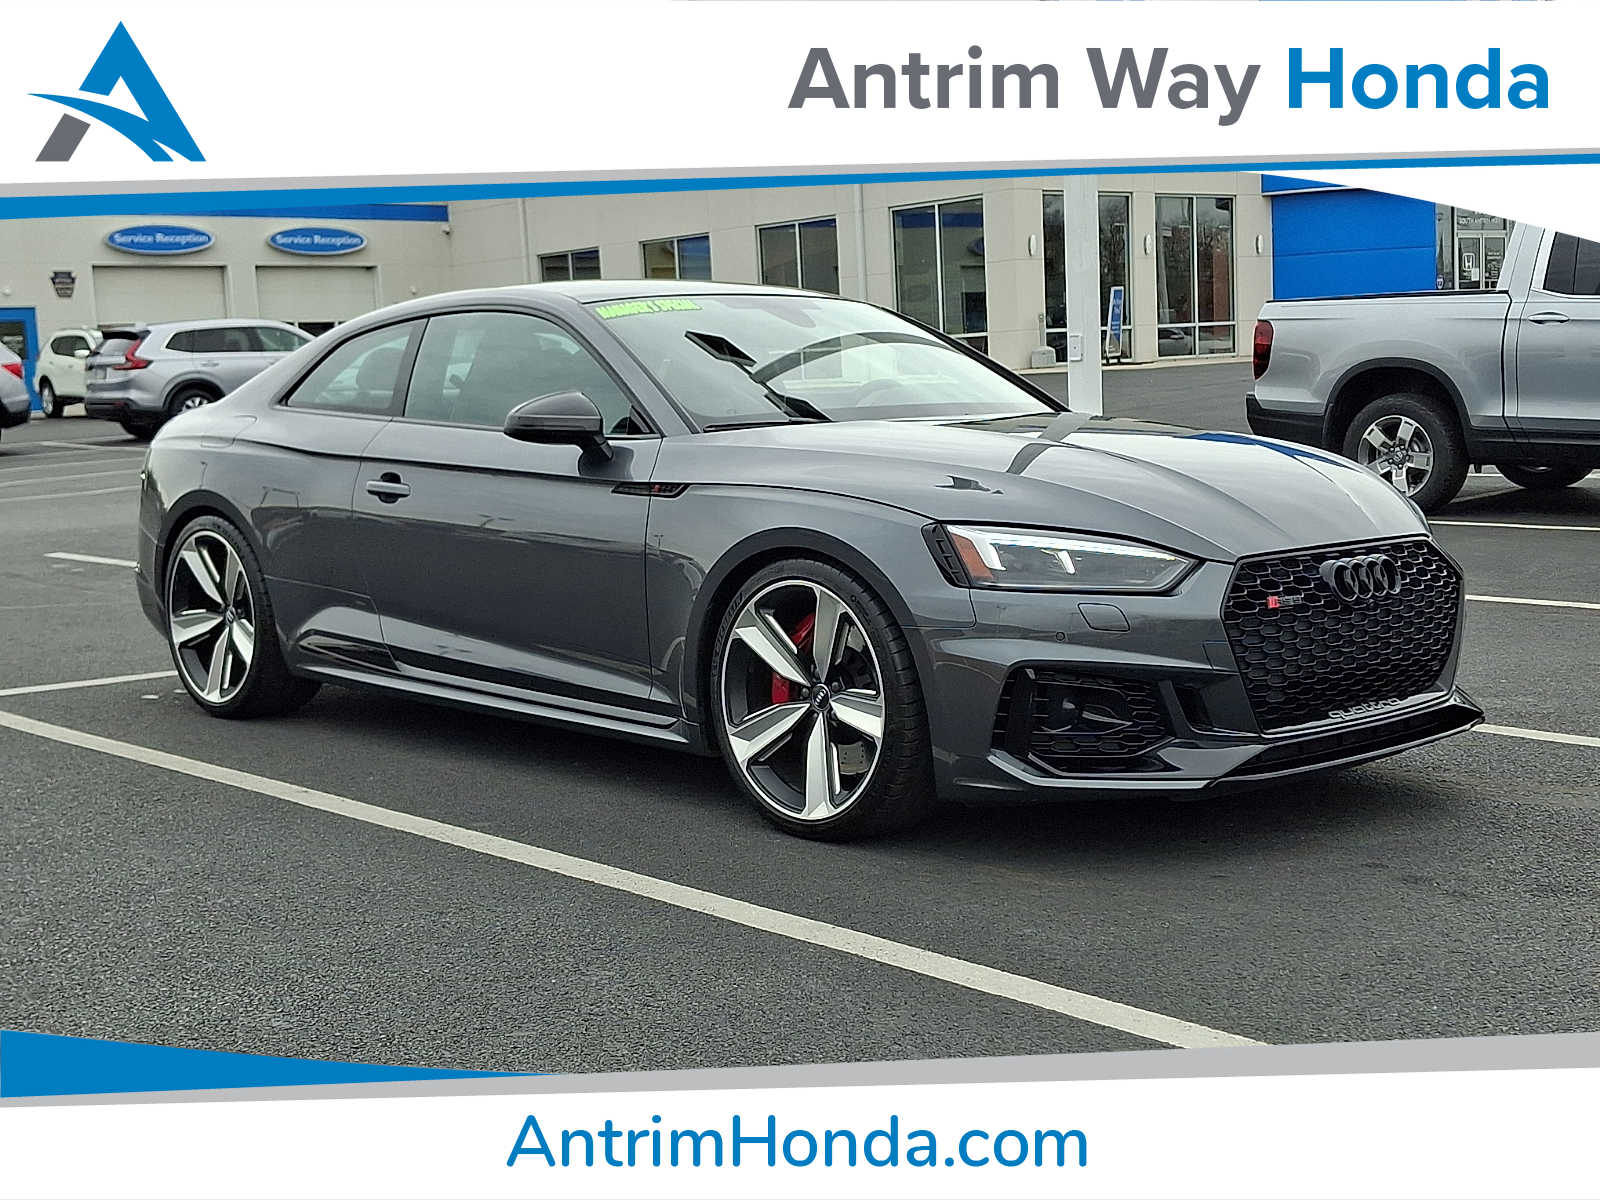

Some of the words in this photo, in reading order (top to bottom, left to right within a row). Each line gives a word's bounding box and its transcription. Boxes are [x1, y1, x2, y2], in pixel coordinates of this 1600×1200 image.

[113, 232, 154, 243] Service
[155, 232, 209, 245] Reception
[275, 234, 312, 245] Service
[313, 234, 361, 247] Reception
[1328, 698, 1400, 720] quattro
